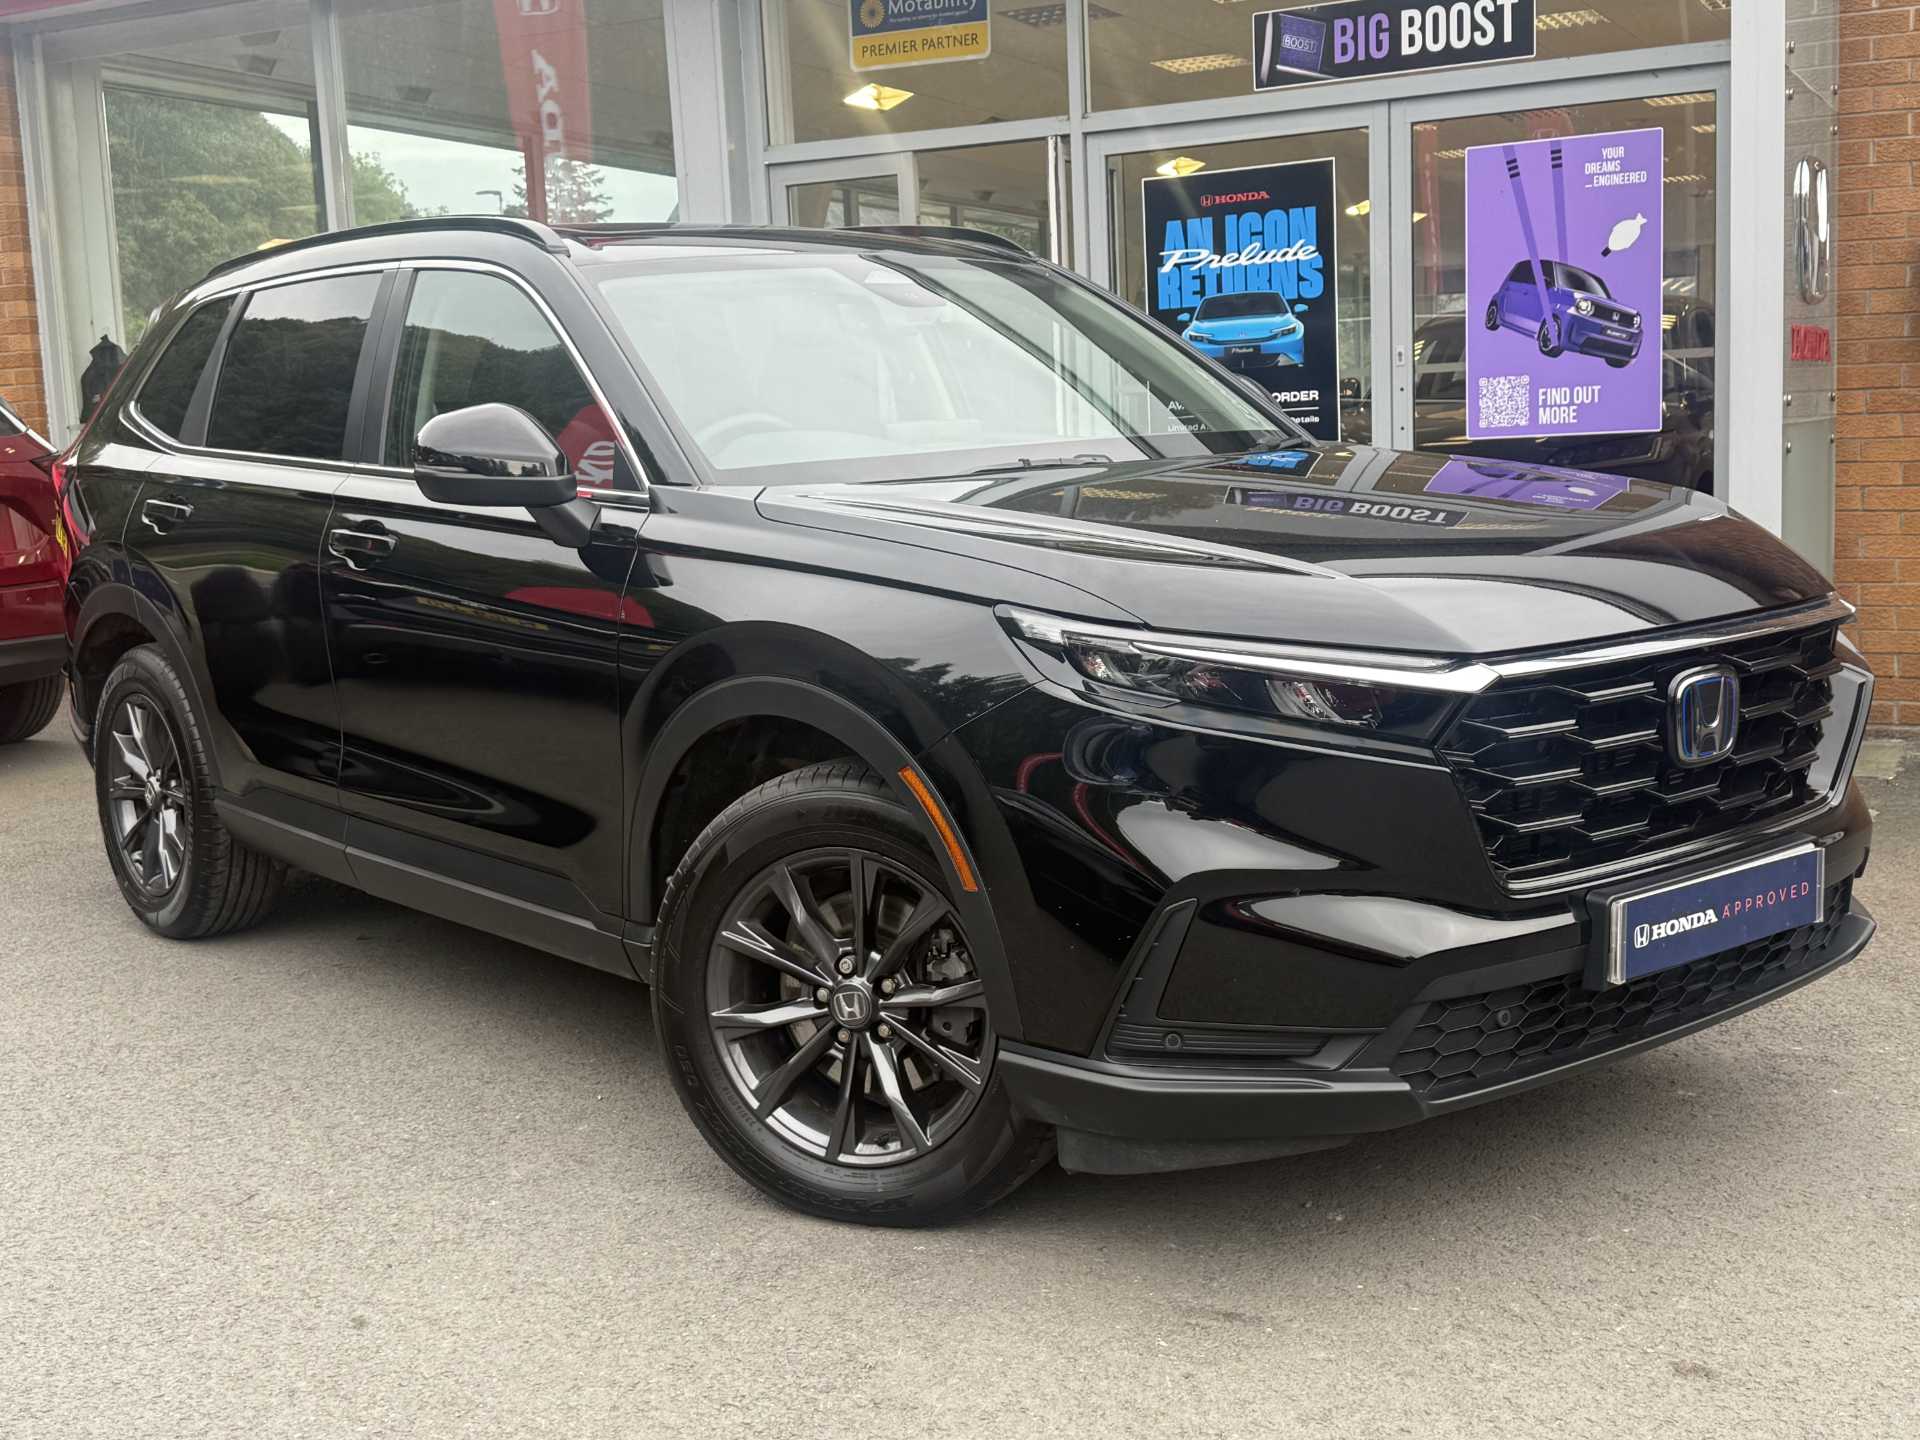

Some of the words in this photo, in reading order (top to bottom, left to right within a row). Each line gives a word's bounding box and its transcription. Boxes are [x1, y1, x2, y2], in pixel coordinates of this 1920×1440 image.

[888, 0, 977, 15] Motability
[1333, 12, 1390, 65] BIG
[1401, 0, 1519, 56] BOOST
[861, 40, 919, 59] PREMIER
[921, 32, 980, 52] PARTNER
[1601, 146, 1625, 159] YOUR
[1584, 160, 1621, 174] DREAMS
[1215, 191, 1270, 204] HONDA
[1163, 217, 1214, 263] AN
[1225, 206, 1317, 254] ICON
[1159, 239, 1319, 273] Prelude
[1157, 255, 1323, 310] RETURNS
[1271, 390, 1320, 403] ORDER
[1538, 387, 1571, 406] FIND
[1574, 385, 1602, 404] OUT
[1538, 405, 1578, 425] MORE
[1651, 908, 1719, 941] HONDA
[1721, 880, 1810, 919] APPROVED
